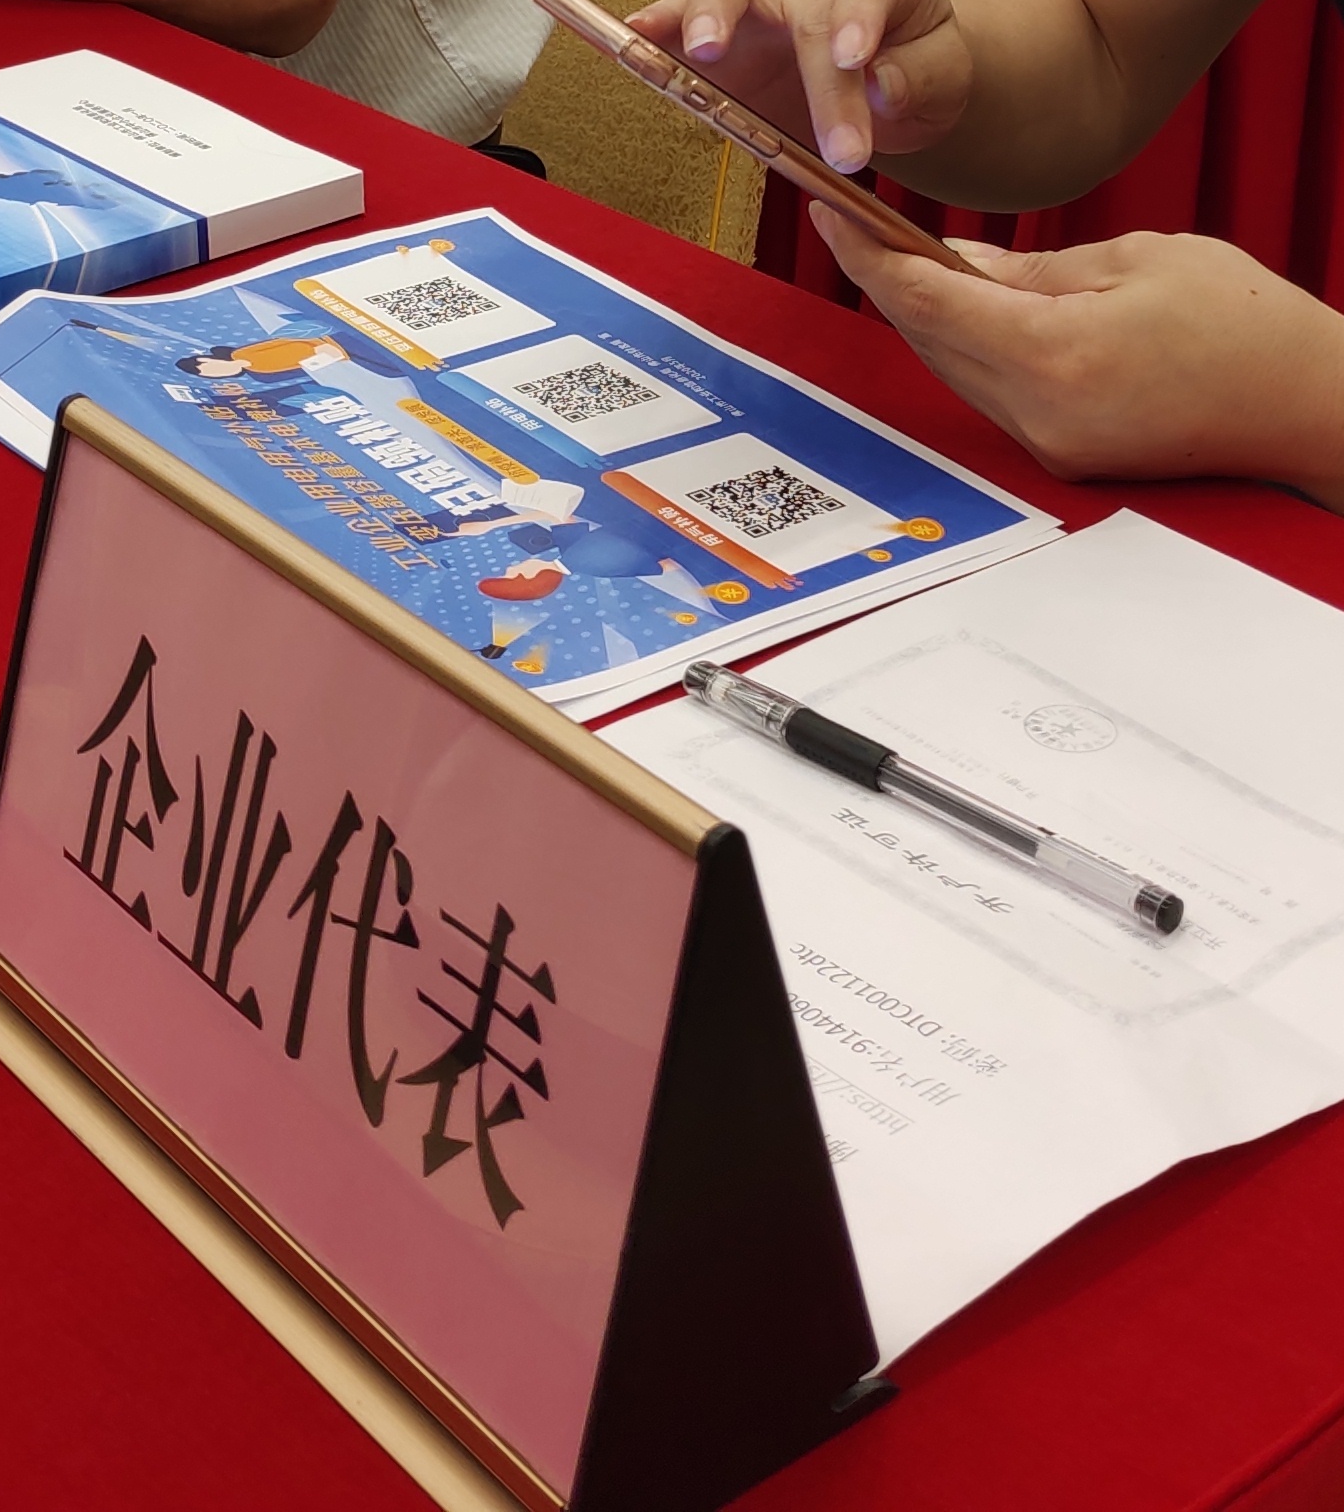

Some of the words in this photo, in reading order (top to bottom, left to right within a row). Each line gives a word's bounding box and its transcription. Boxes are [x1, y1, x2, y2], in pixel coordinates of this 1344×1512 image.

[209, 383, 446, 544] 变压器容量基本电费补贴
[303, 395, 509, 516] 扫码领补贴
[484, 397, 544, 431] 用电补贴
[197, 404, 440, 571] 工业企业用电用气补贴
[657, 506, 724, 547] 用气补贴
[832, 806, 1015, 915] 开户许可证
[62, 634, 556, 1231] 企业代表
